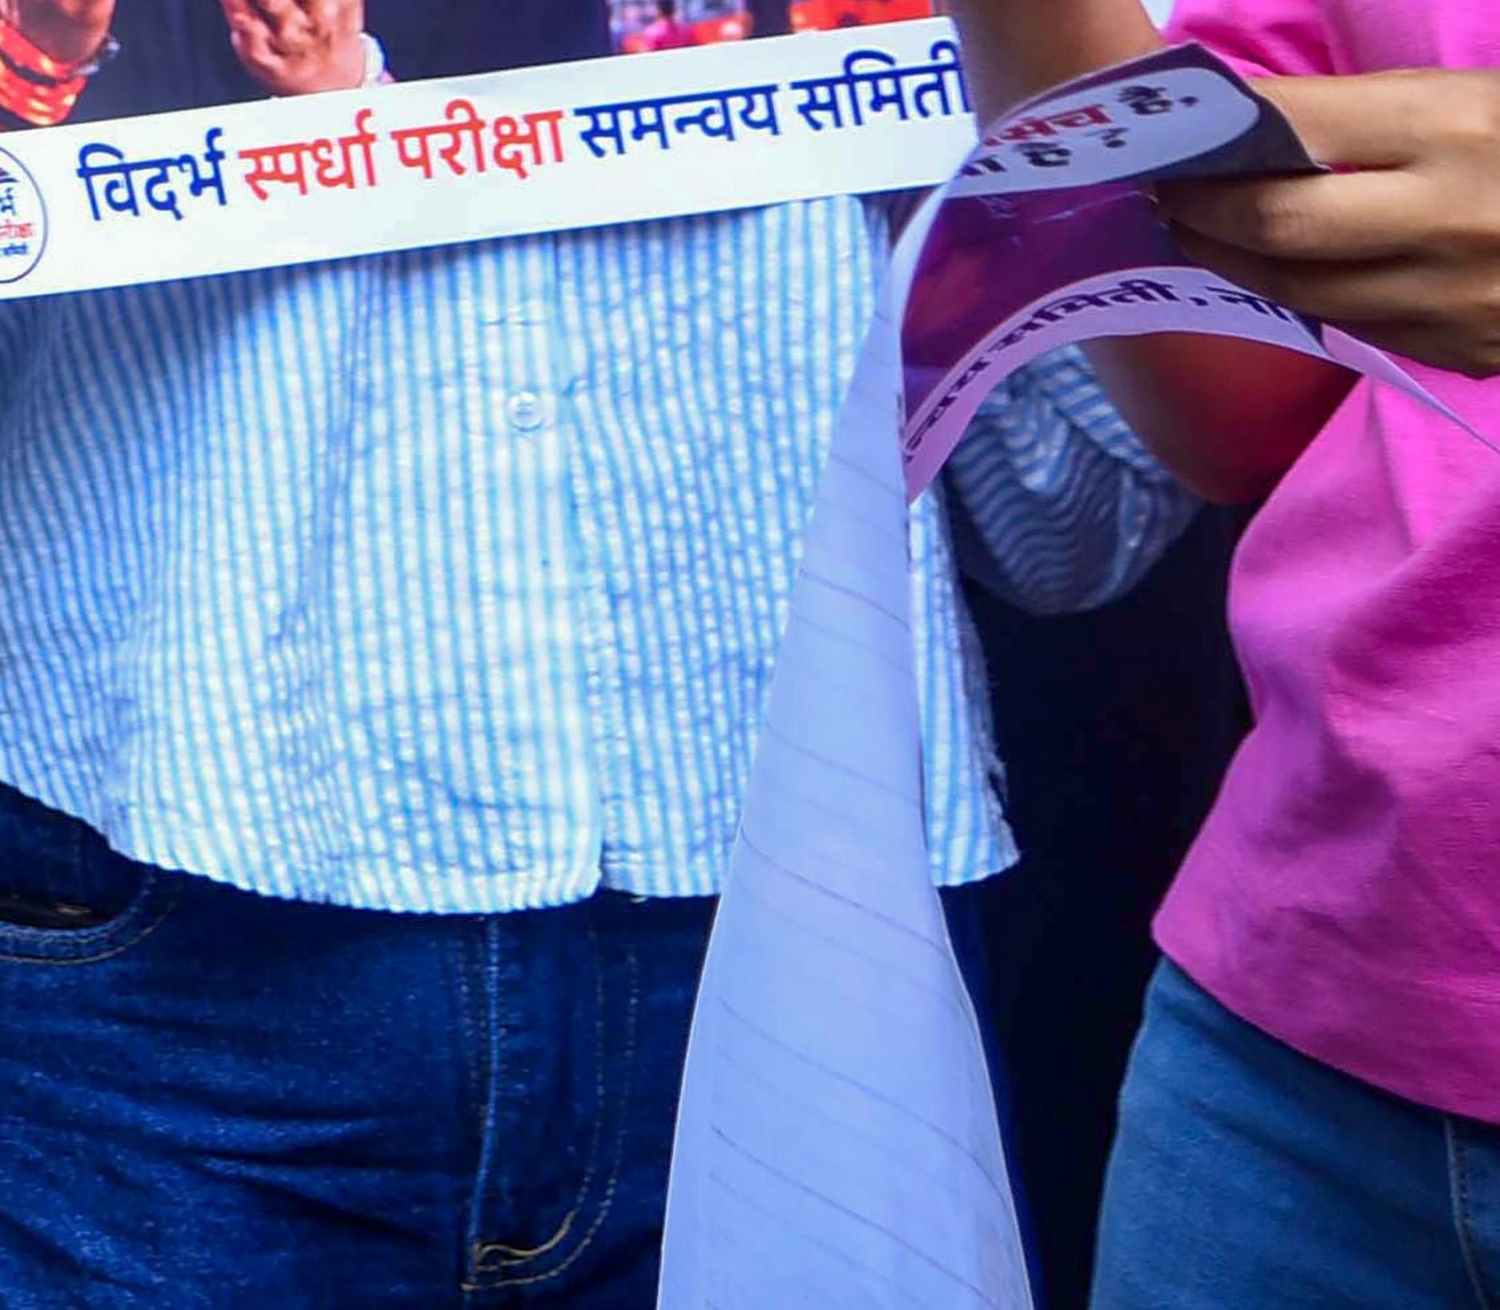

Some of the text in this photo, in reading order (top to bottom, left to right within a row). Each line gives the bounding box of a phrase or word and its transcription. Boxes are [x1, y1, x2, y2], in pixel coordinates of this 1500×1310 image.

[78, 40, 974, 222] विदर्भ स्पर्धा परीक्षा समन्वय समिती
